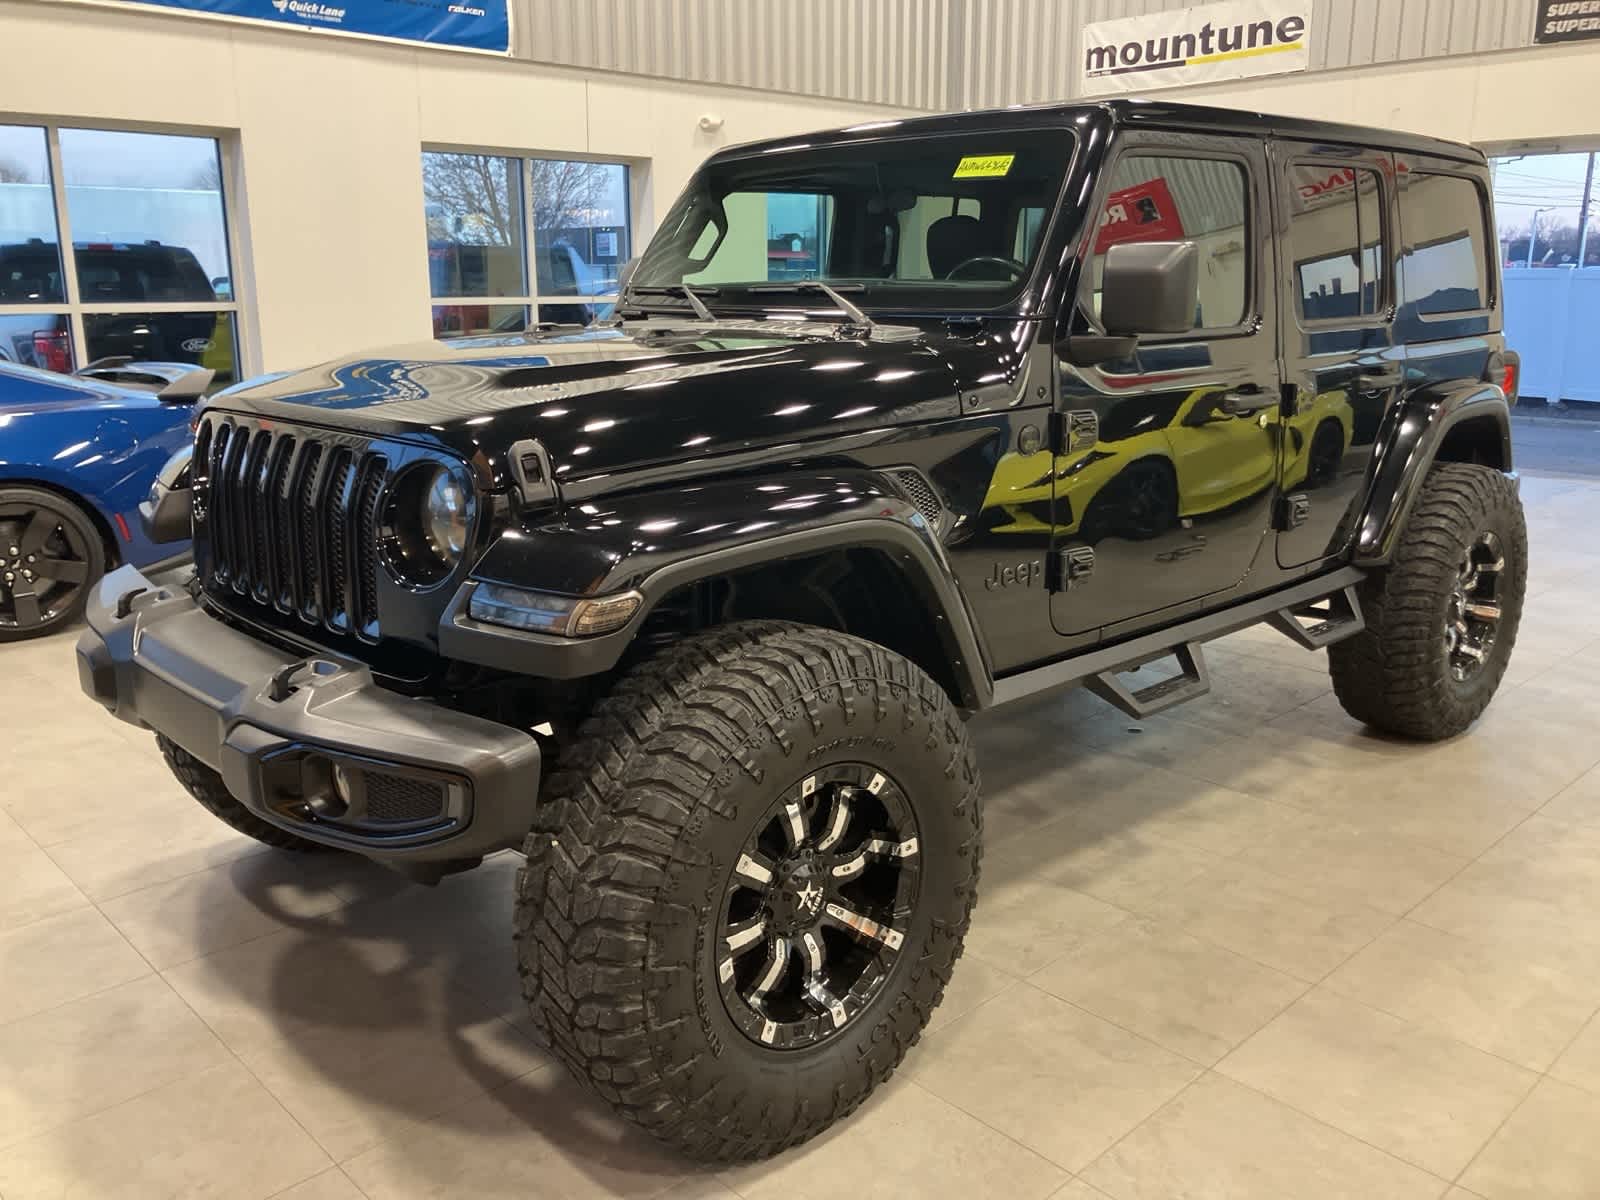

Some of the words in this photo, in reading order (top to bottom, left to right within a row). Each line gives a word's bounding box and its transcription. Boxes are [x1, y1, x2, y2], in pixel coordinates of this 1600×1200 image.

[288, 0, 319, 14] Quick
[319, 4, 346, 17] Lane
[448, 4, 486, 17] FALKEN
[1085, 15, 1305, 71] mountune
[984, 560, 1040, 592] Jeep
